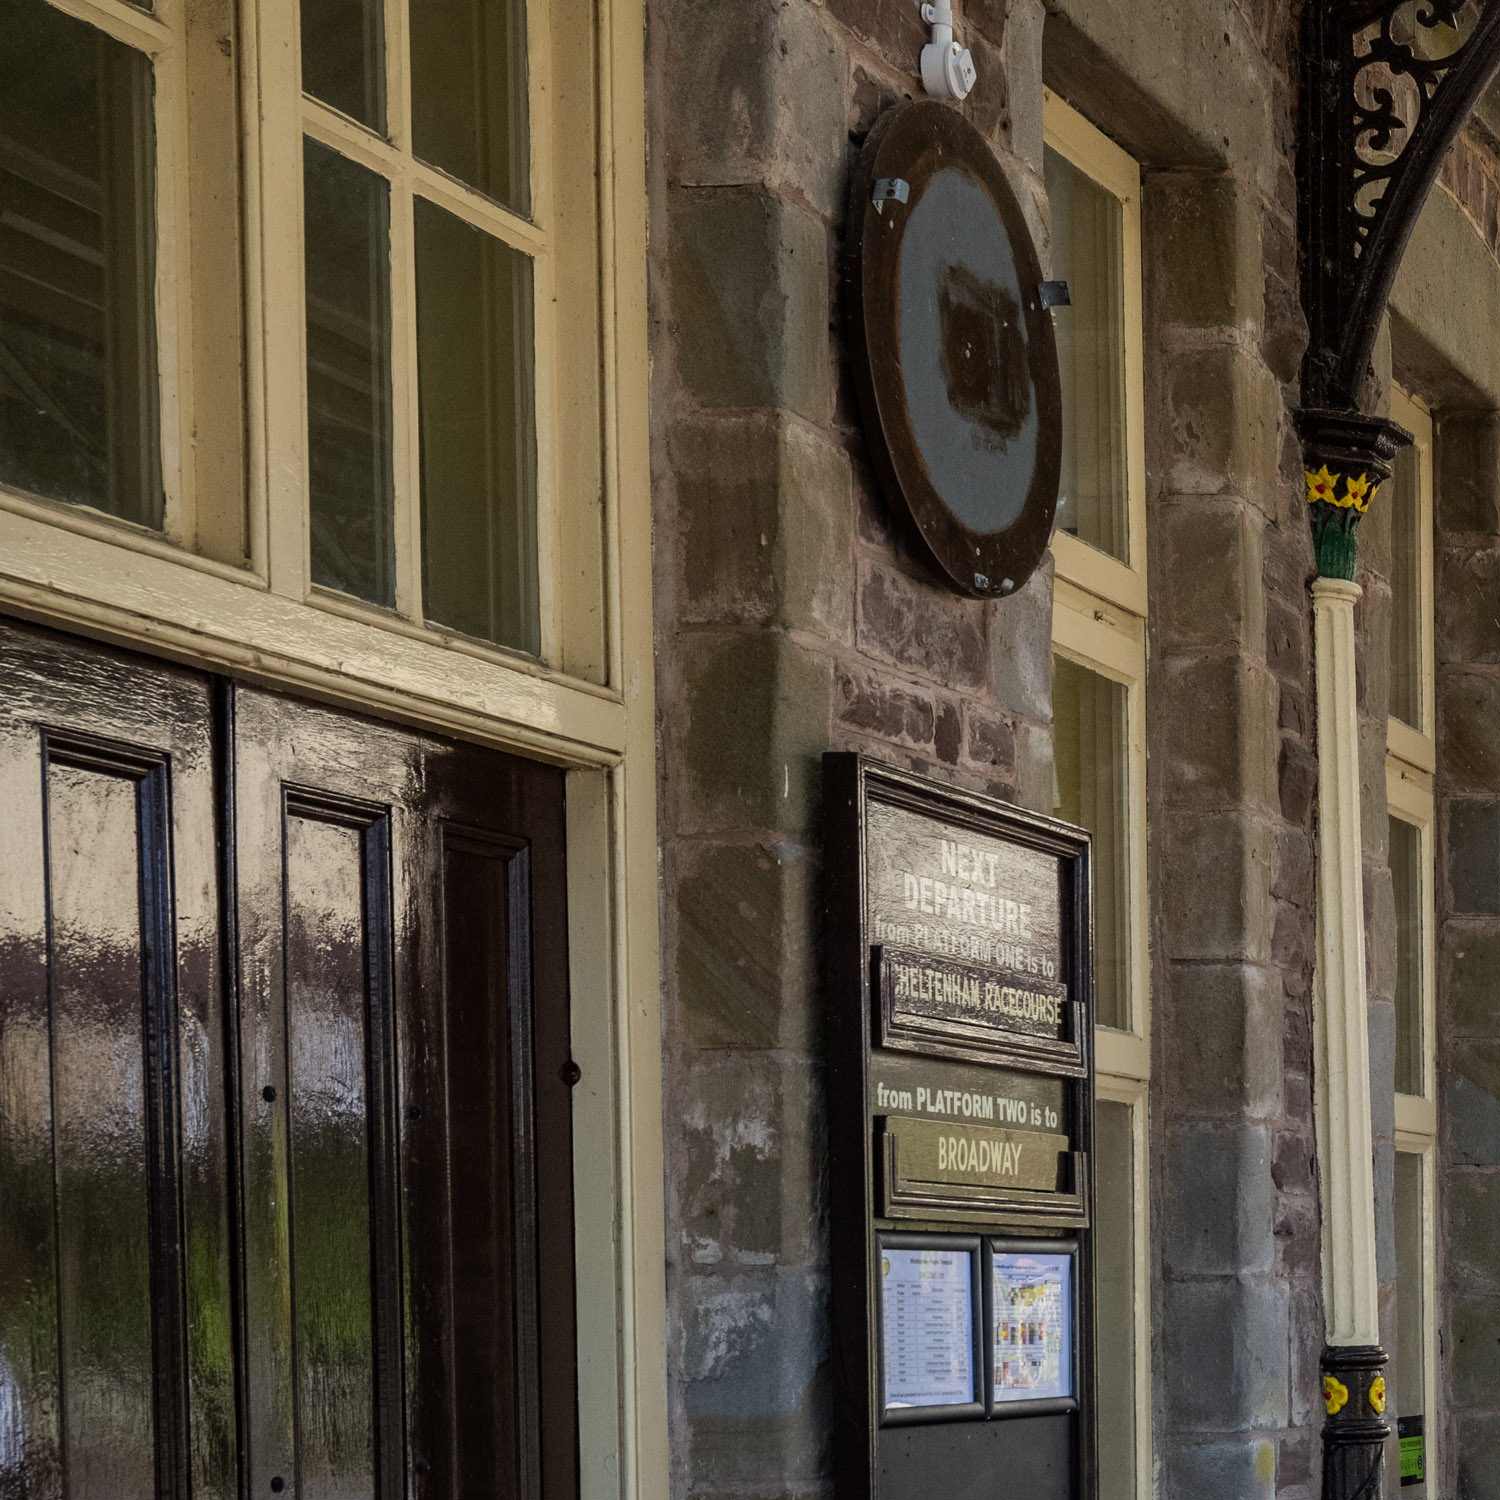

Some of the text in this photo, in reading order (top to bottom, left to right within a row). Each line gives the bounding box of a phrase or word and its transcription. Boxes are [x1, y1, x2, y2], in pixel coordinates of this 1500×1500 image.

[941, 839, 999, 888] NEXT
[903, 872, 1033, 939] DEPARTURE
[875, 915, 1055, 978] from PLATFORM ONE is to
[985, 982, 1063, 1024] RACECOURSE
[877, 1081, 1058, 1128] from PLATFORM TWO is to
[938, 1136, 1023, 1176] BROADWAY
